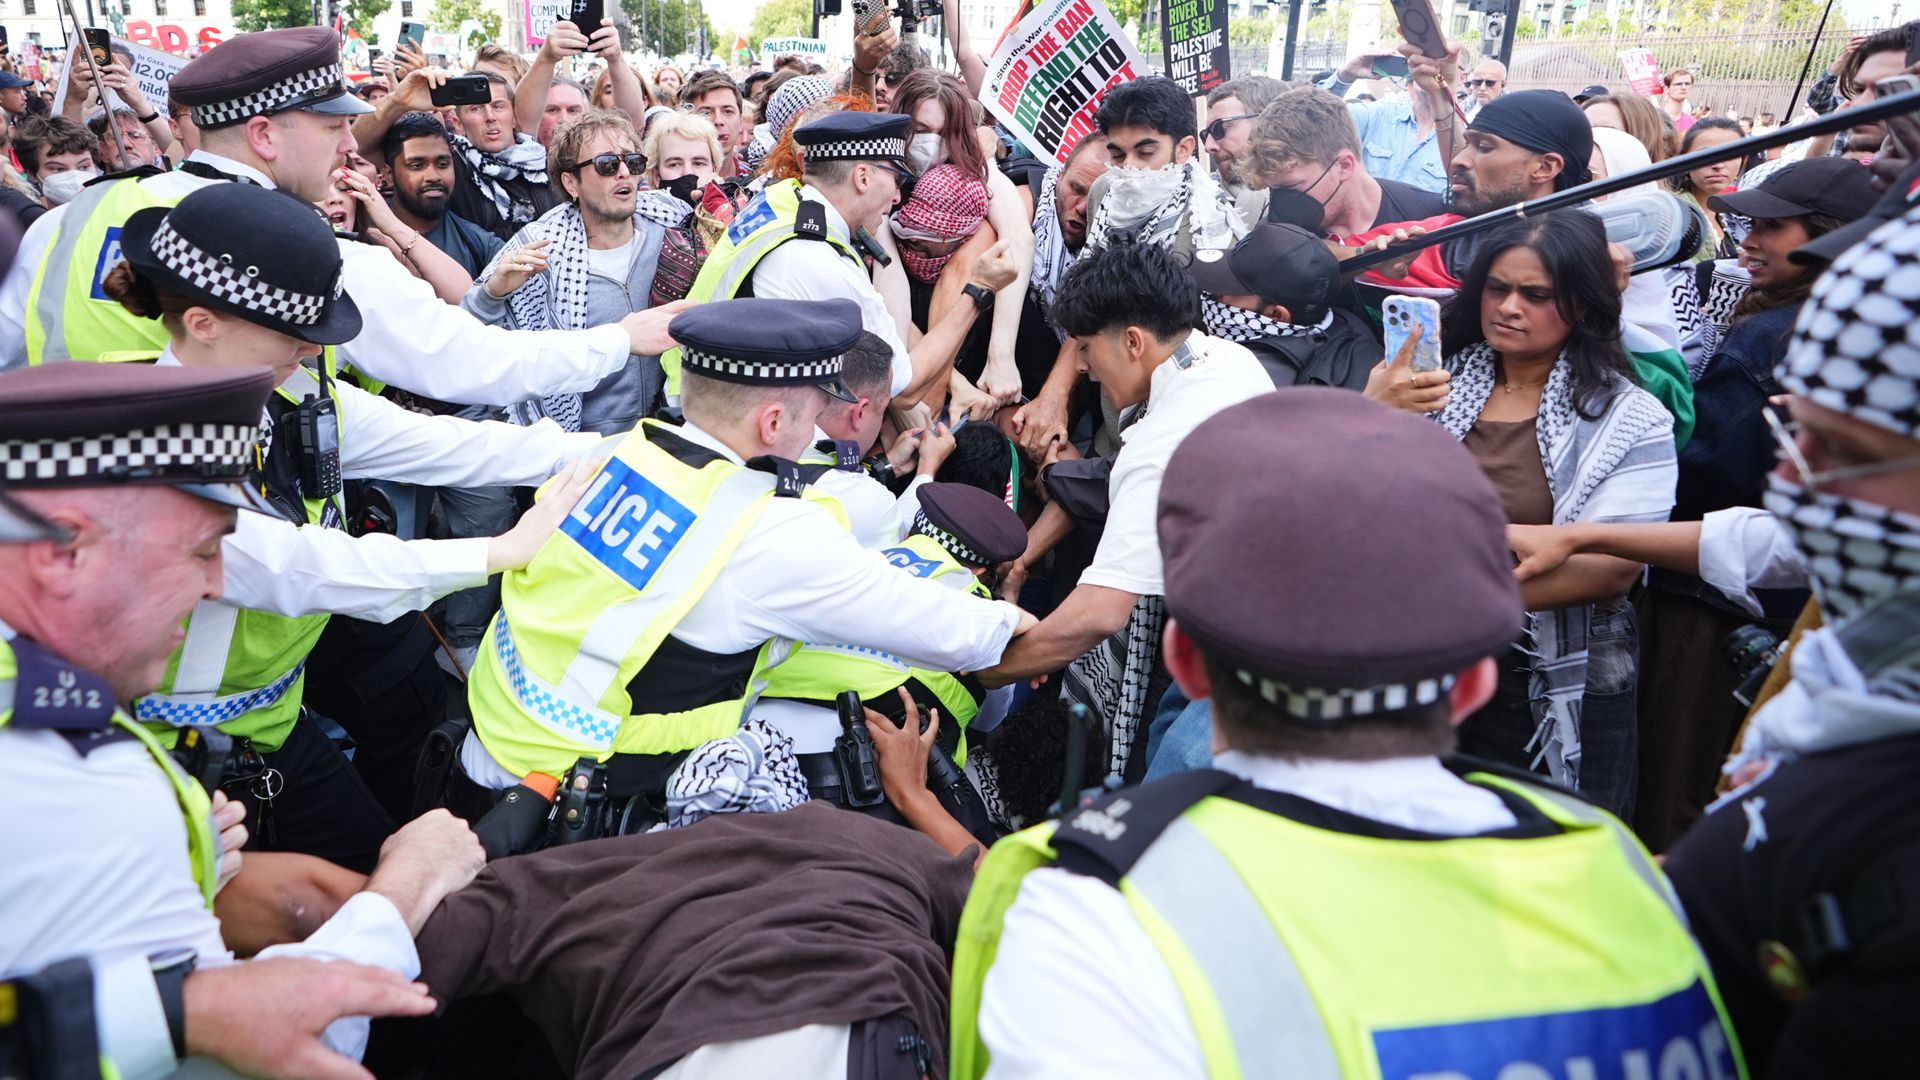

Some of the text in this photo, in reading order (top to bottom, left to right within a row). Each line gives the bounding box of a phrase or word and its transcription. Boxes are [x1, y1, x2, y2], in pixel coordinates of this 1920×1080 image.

[1168, 1, 1198, 25] RIVER
[1203, 0, 1215, 14] TO
[1169, 15, 1212, 43] THE SEA
[763, 41, 827, 54] PALESTINIAN
[996, 57, 1012, 80] Stop
[1011, 44, 1026, 57] the
[1025, 26, 1043, 44] War
[998, 0, 1094, 115] DROP THE BAN
[1170, 28, 1222, 62] PALESTINE
[1014, 16, 1110, 134] DEFEND THE
[1171, 57, 1197, 80] WILL
[1199, 52, 1212, 73] BE
[1033, 38, 1127, 156] RIGHT TO
[802, 223, 820, 232] 2773
[847, 447, 854, 456] U
[792, 467, 799, 480] U
[570, 471, 677, 570] LICE
[58, 670, 77, 688] U
[33, 686, 102, 709] 2512
